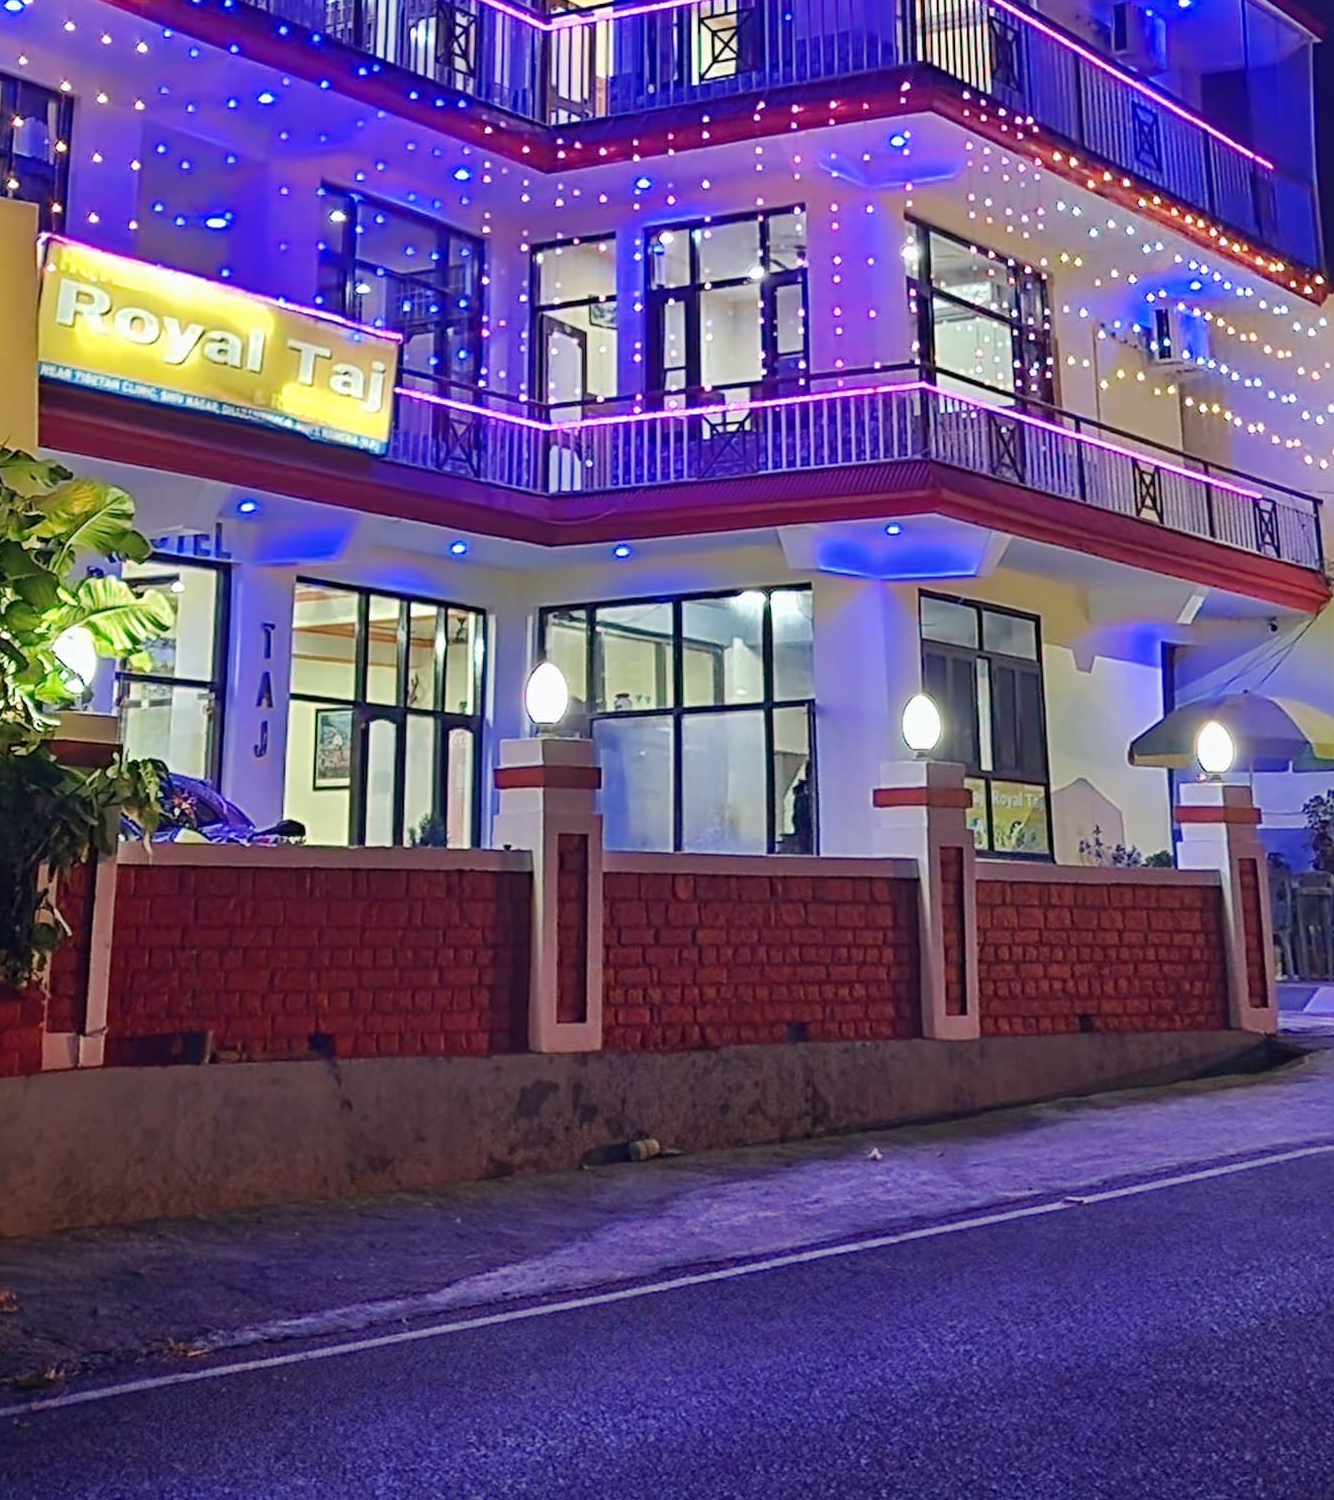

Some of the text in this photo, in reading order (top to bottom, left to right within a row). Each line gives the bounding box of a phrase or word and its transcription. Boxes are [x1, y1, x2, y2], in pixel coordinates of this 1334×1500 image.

[55, 278, 388, 413] Royal Taj
[254, 623, 275, 758] TAJ
